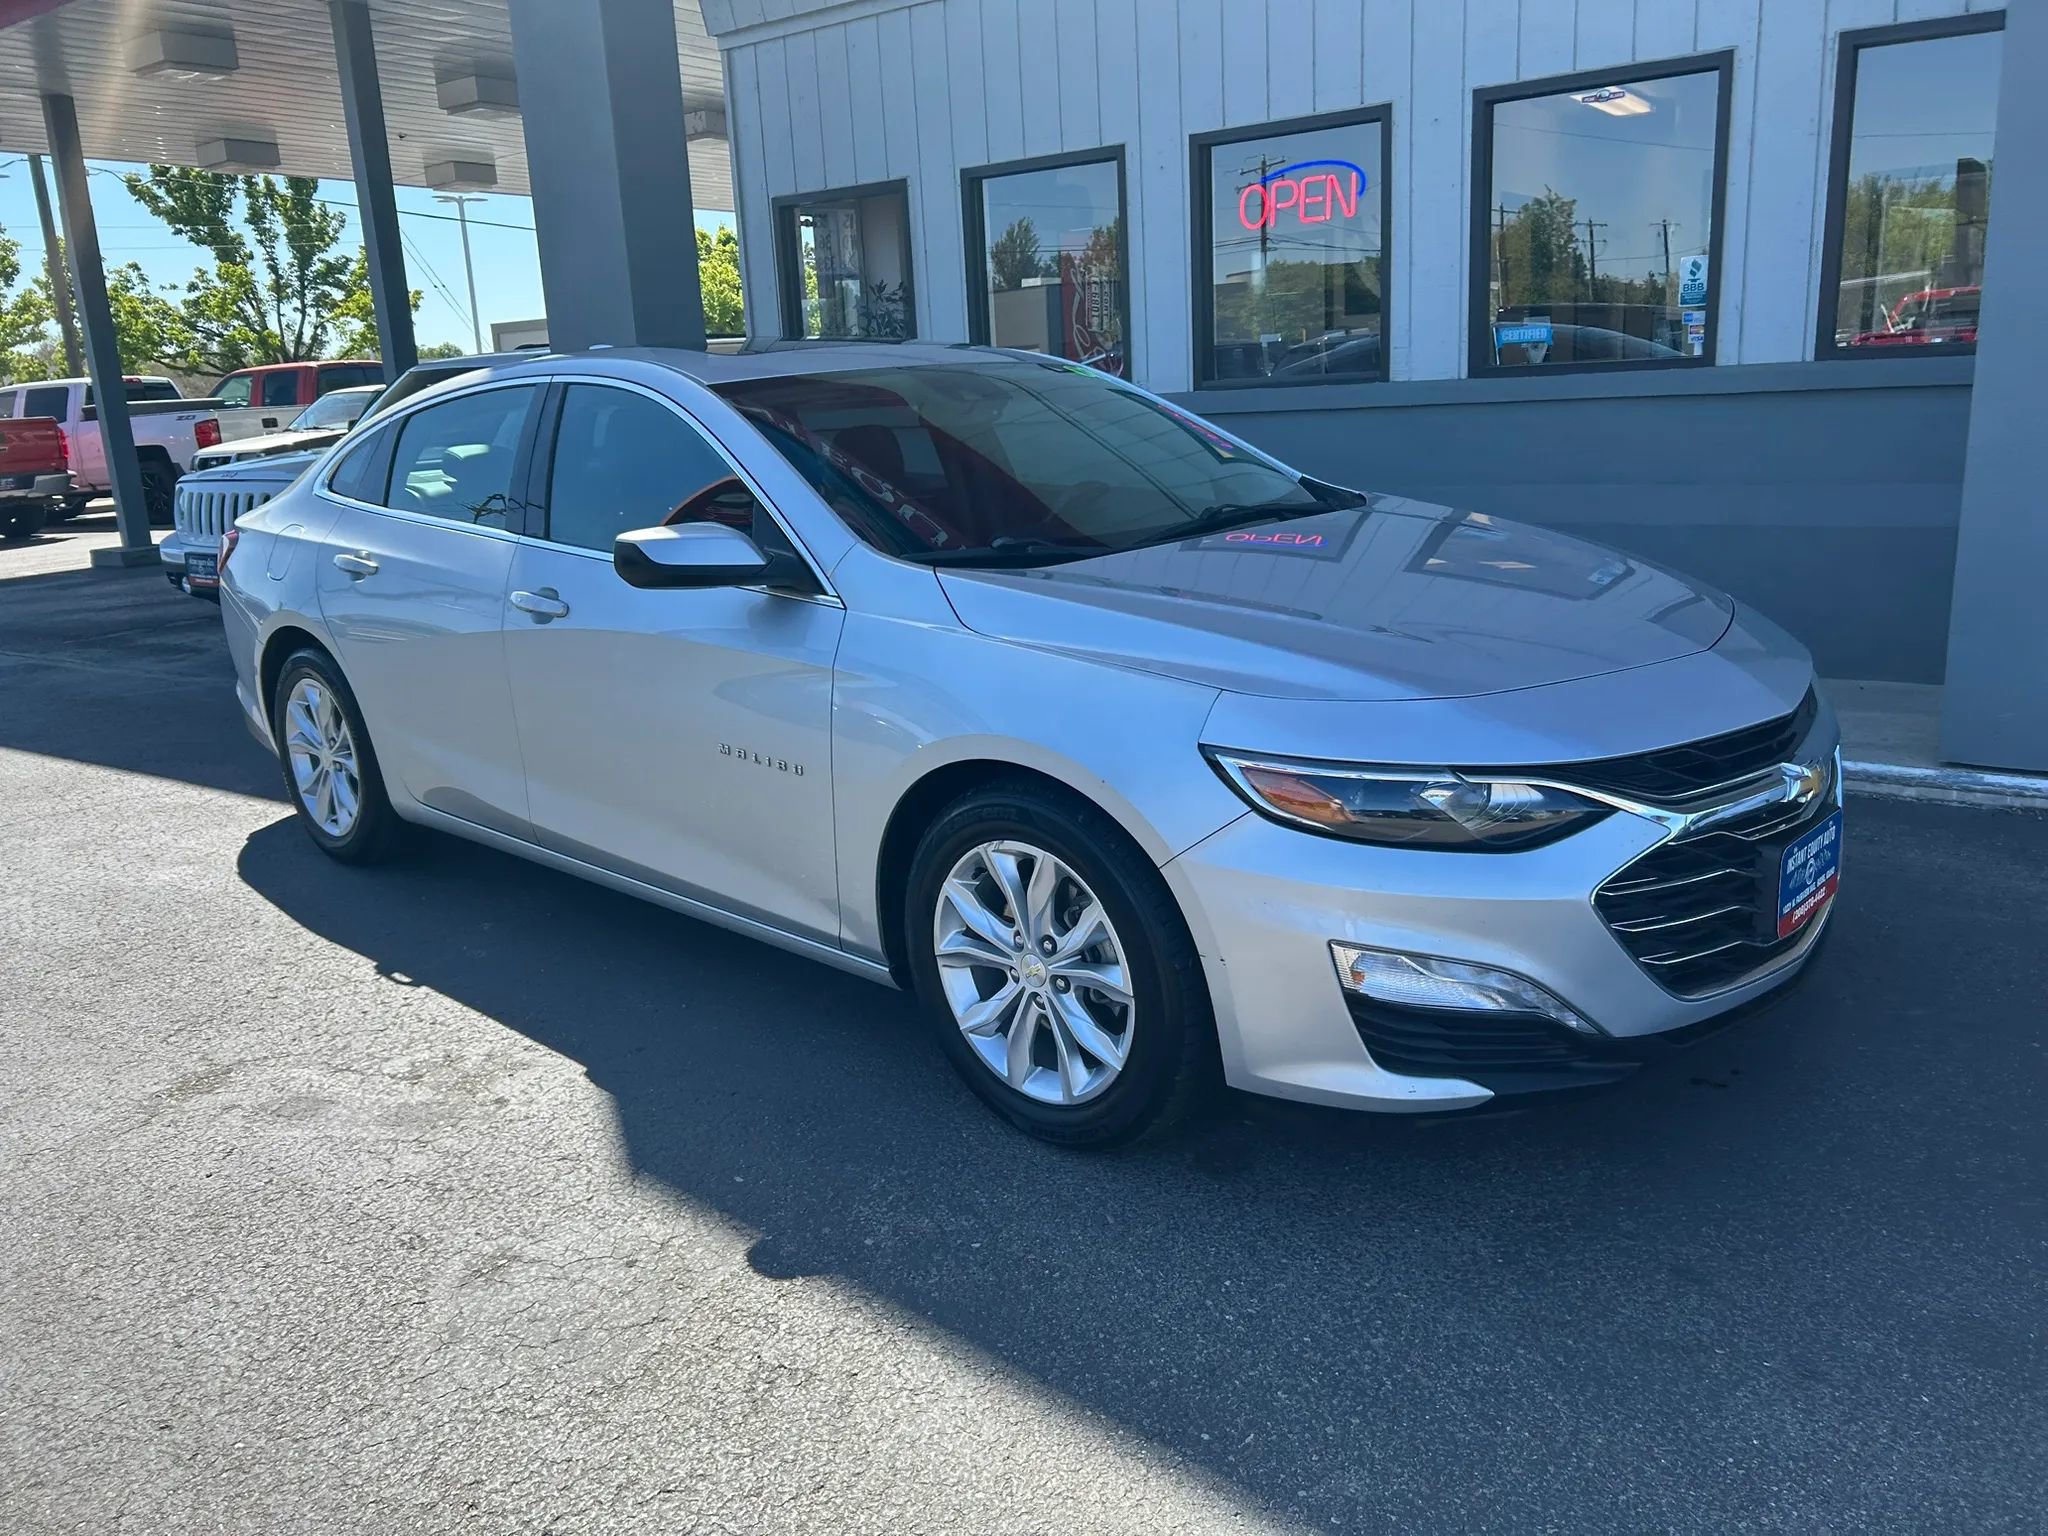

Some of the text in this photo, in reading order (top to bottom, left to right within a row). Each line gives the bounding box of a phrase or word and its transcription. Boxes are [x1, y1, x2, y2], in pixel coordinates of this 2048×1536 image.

[1239, 171, 1357, 230] OPEN
[1682, 282, 1704, 292] BBB
[1501, 327, 1547, 342] CERTIFIED
[718, 743, 804, 777] MALIBU
